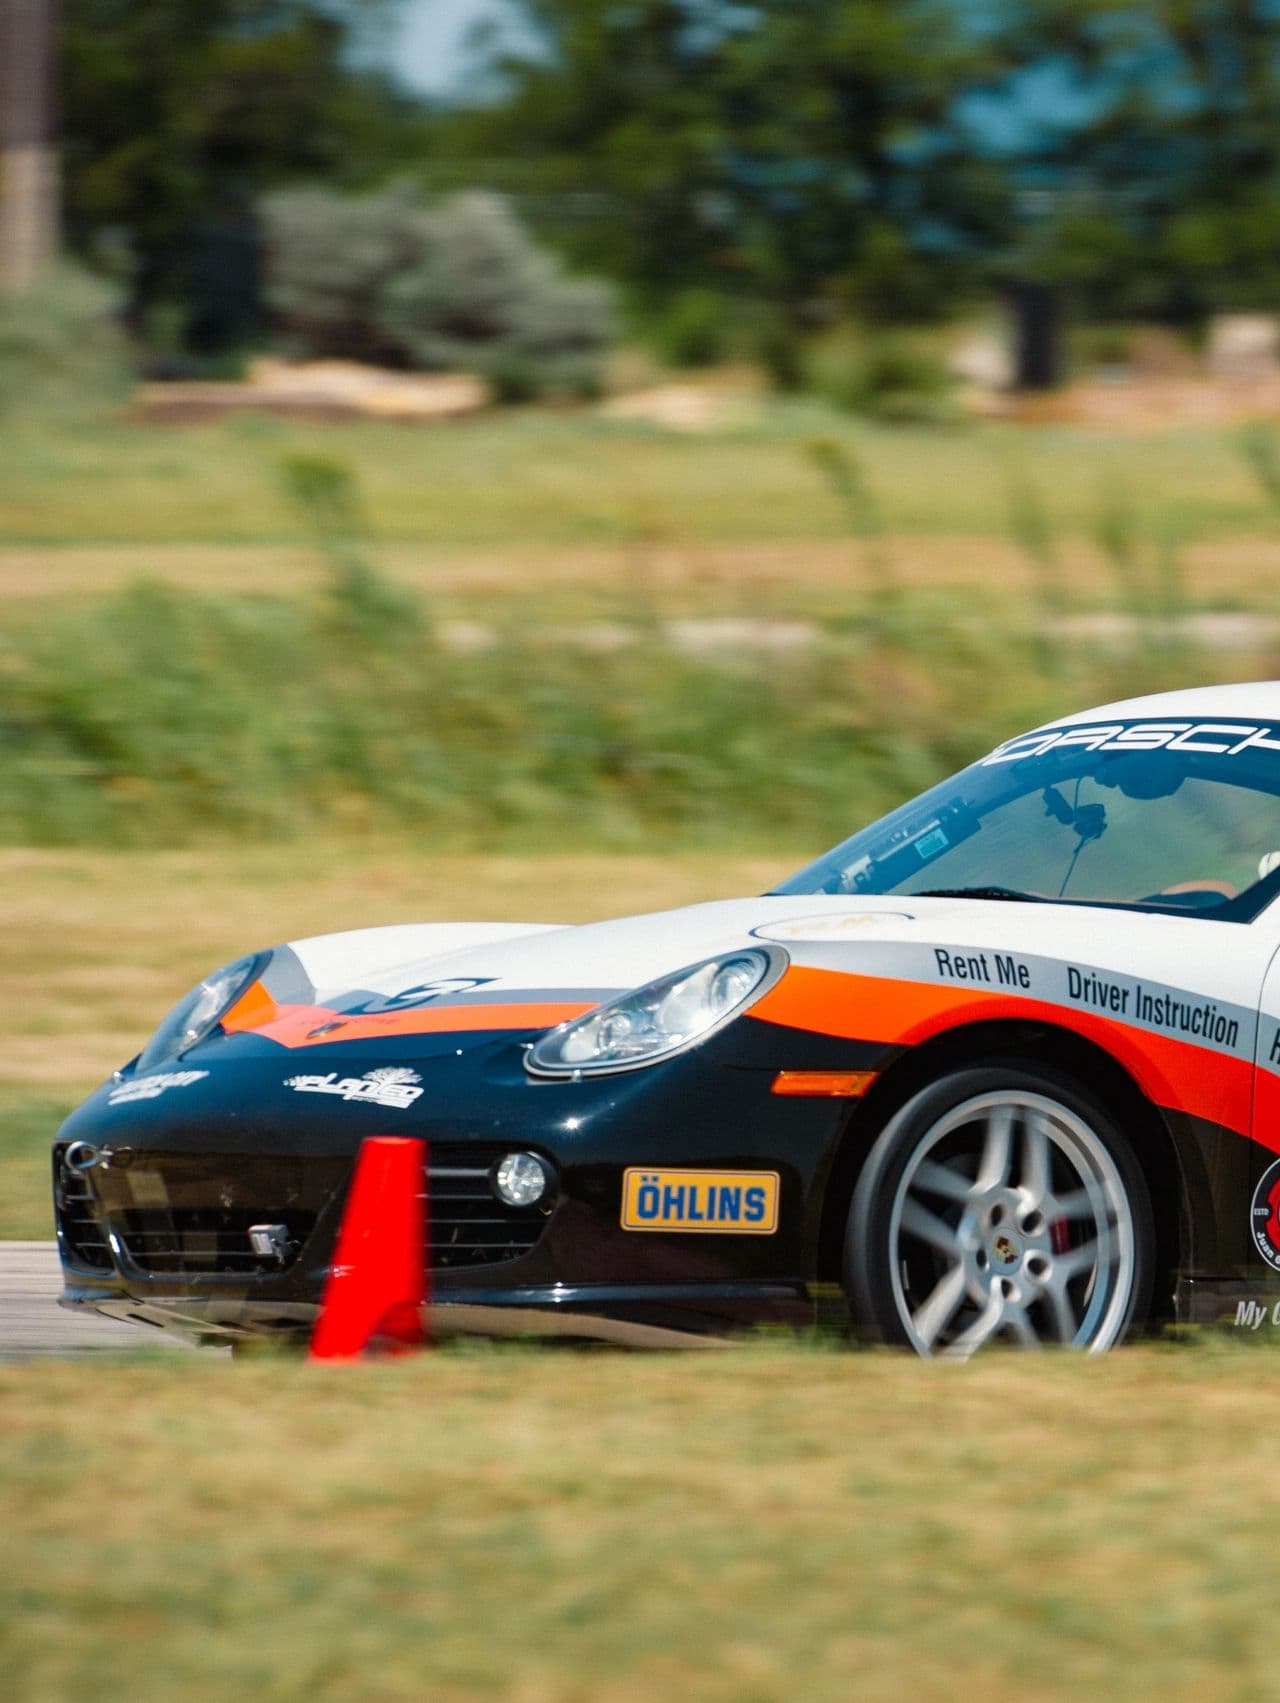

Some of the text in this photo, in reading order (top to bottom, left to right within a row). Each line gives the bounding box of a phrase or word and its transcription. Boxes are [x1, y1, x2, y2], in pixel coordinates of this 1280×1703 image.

[934, 948, 1031, 989] Rent Me
[1067, 967, 1240, 1048] Driver Instruction
[637, 1176, 766, 1221] ÖHLINS
[1234, 1300, 1267, 1330] My
